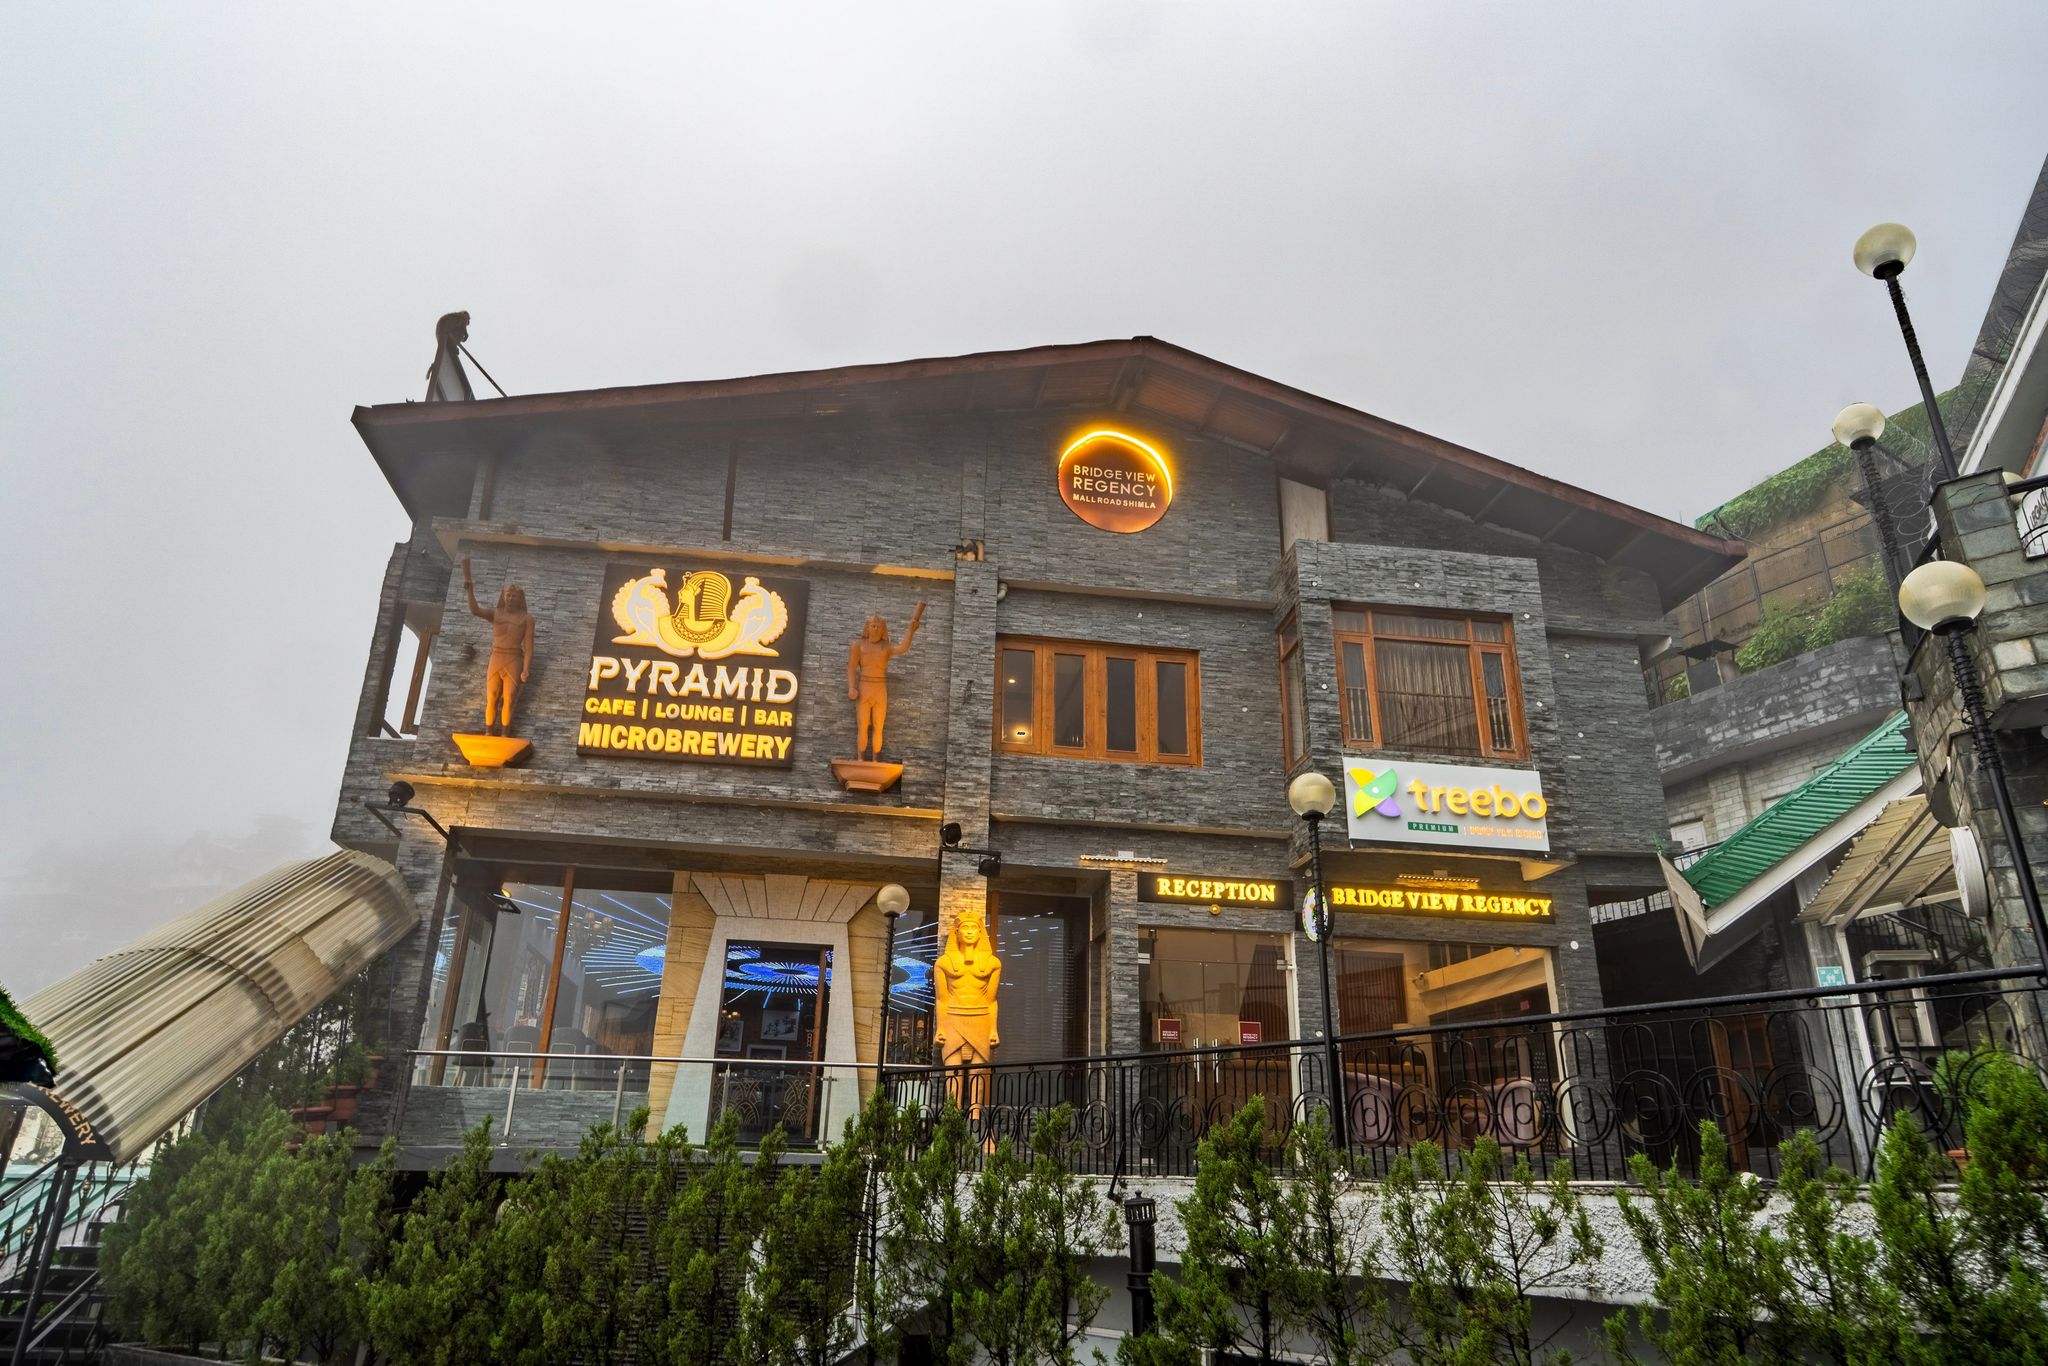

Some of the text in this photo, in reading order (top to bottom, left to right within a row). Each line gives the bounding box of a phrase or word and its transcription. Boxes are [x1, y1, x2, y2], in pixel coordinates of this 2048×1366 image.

[1073, 464, 1156, 483] BRIDGE VIEW
[1073, 476, 1156, 497] REGENCY
[1072, 493, 1156, 509] MALL ROAD SHIMLA
[588, 656, 798, 704] PYRAMID
[585, 697, 636, 716] CAFE
[655, 702, 734, 723] LOUNGE
[754, 709, 793, 727] BAR
[578, 722, 792, 760] MICROBREWERY
[1407, 778, 1547, 819] treebo
[1412, 823, 1455, 833] PREMIUM
[1157, 878, 1276, 902] RECEPTION
[1331, 887, 1552, 916] BRIDGE VIEW REGENCY
